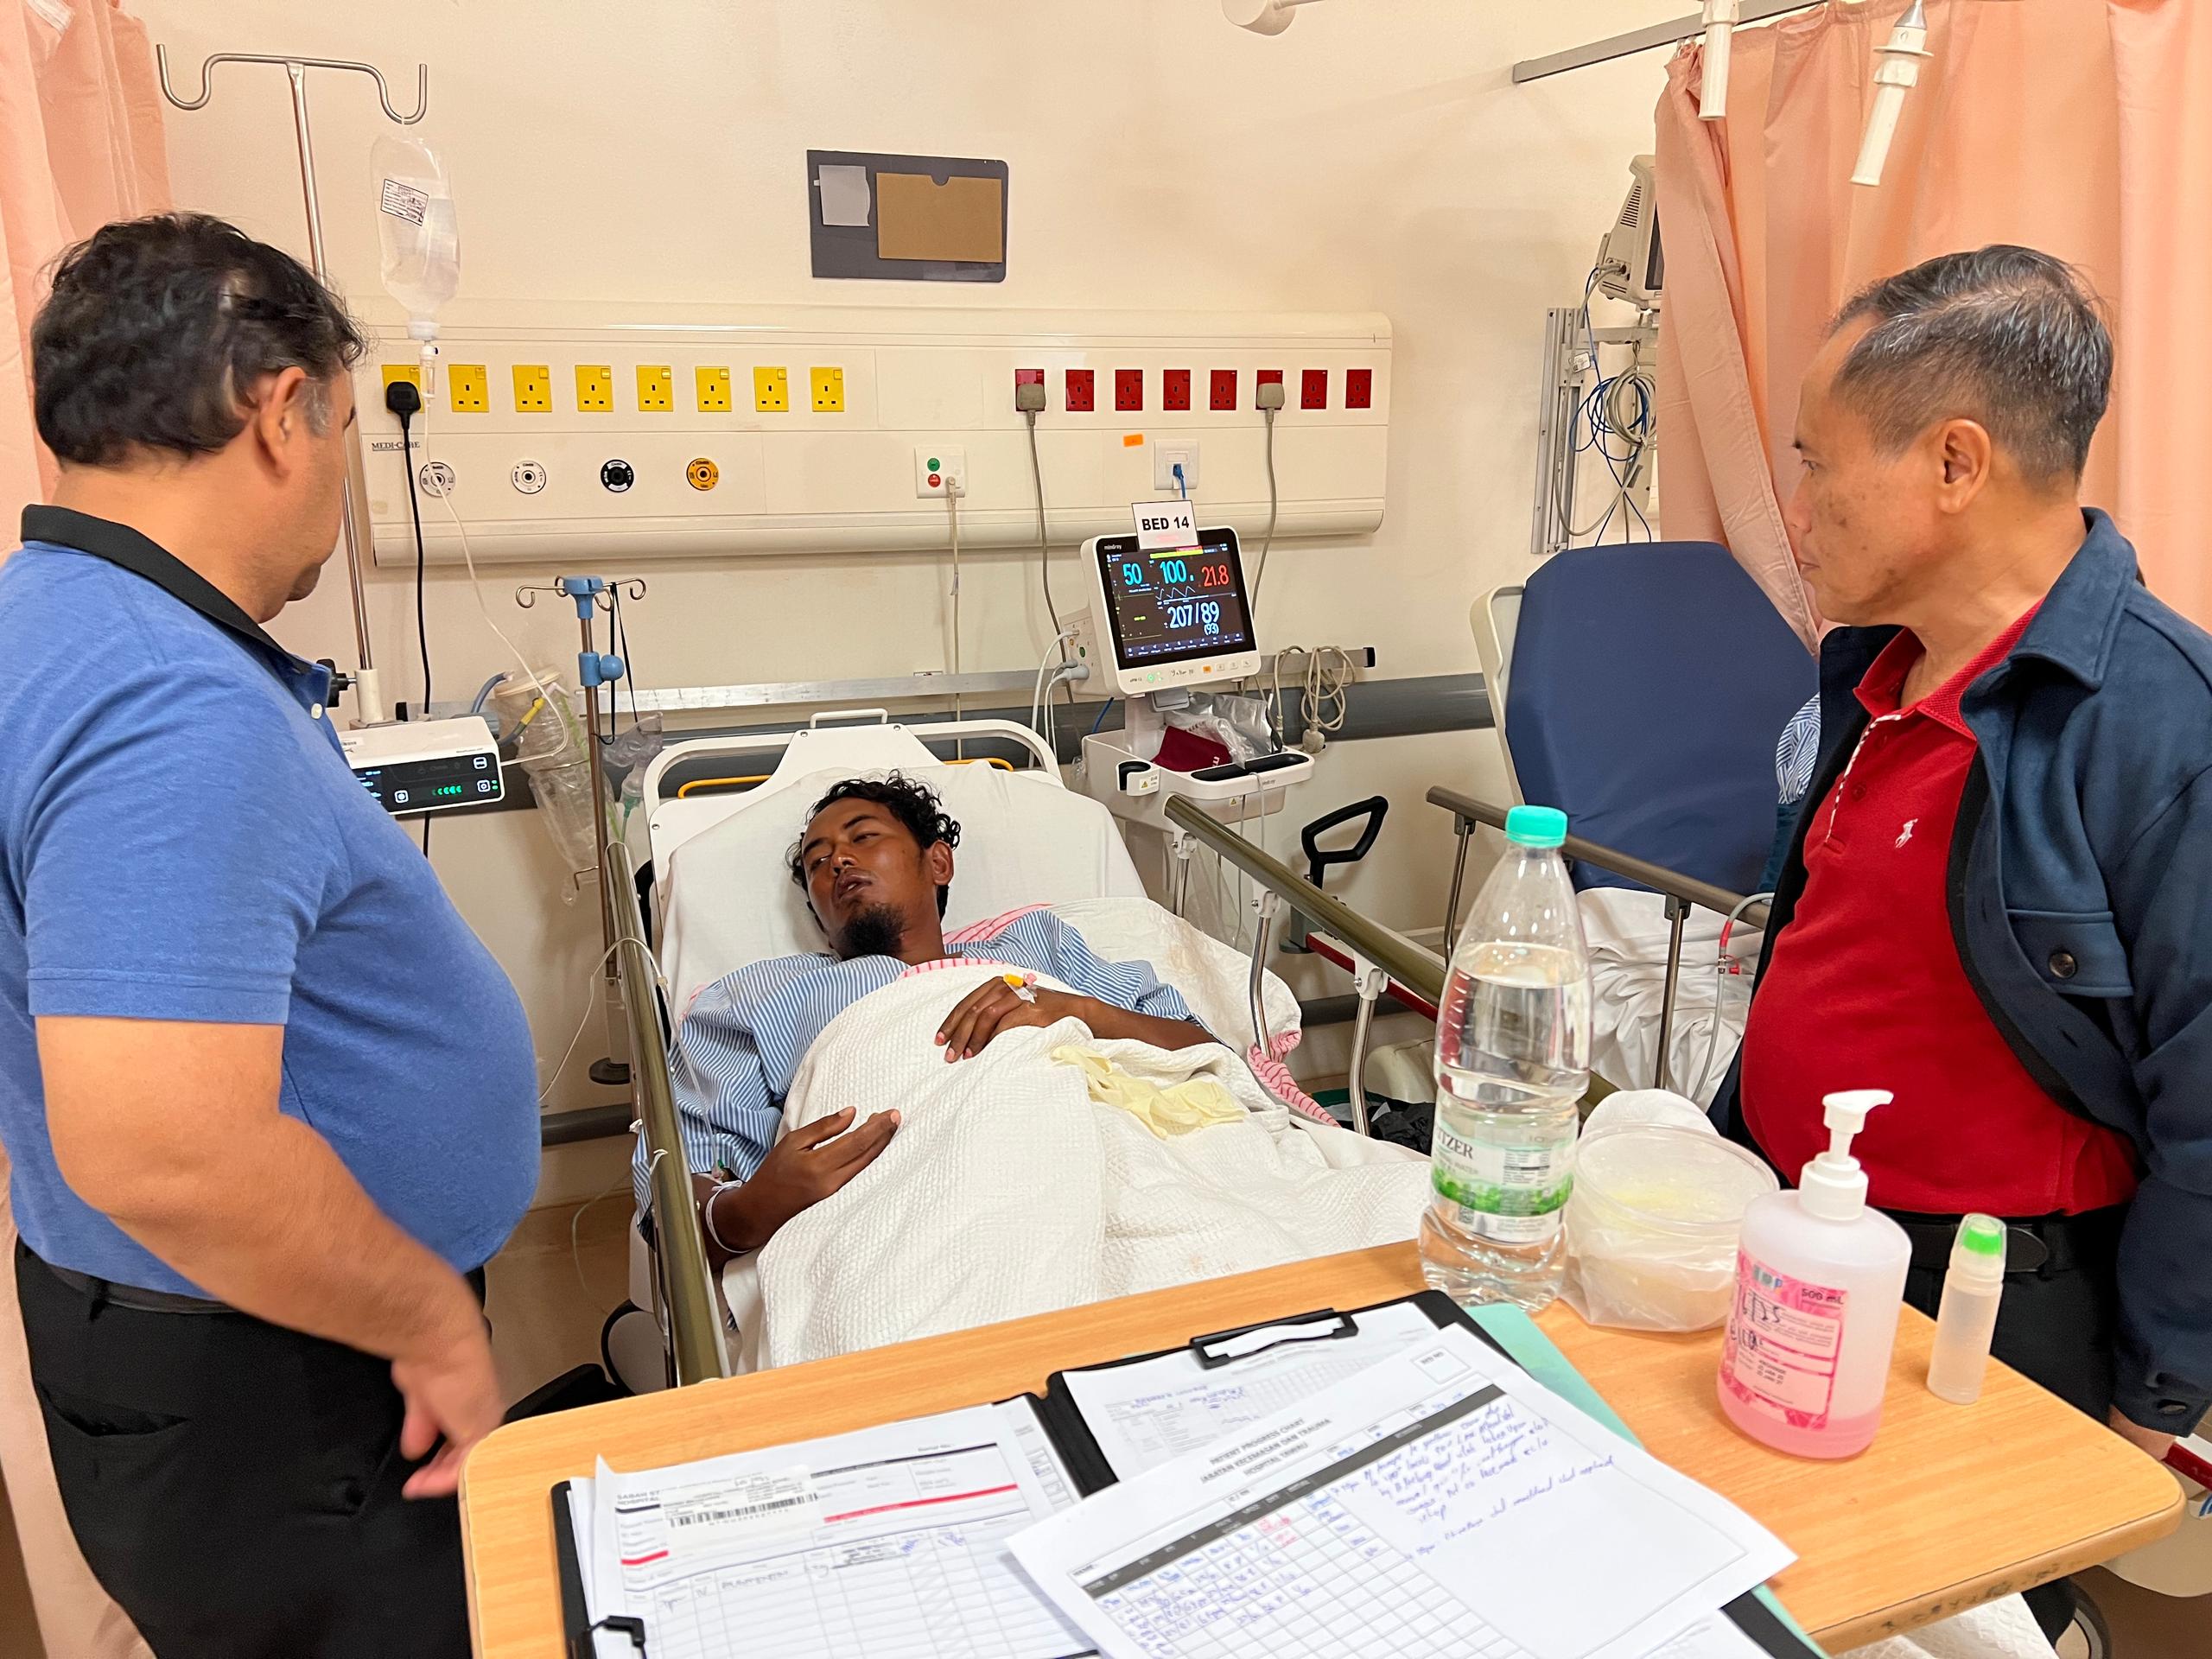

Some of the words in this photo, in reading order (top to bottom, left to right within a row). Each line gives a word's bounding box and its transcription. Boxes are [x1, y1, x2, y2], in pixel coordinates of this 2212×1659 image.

[372, 442, 420, 450] MEDI-CRE
[1141, 518, 1169, 531] BED
[1174, 516, 1189, 529] 14
[1122, 563, 1142, 585] 50
[1160, 560, 1187, 584] 100
[1202, 564, 1230, 587] 21.8
[1242, 1430, 1281, 1450] PROGRESS
[1280, 1418, 1306, 1434] CHART
[1243, 1457, 1281, 1477] HOSPITAL
